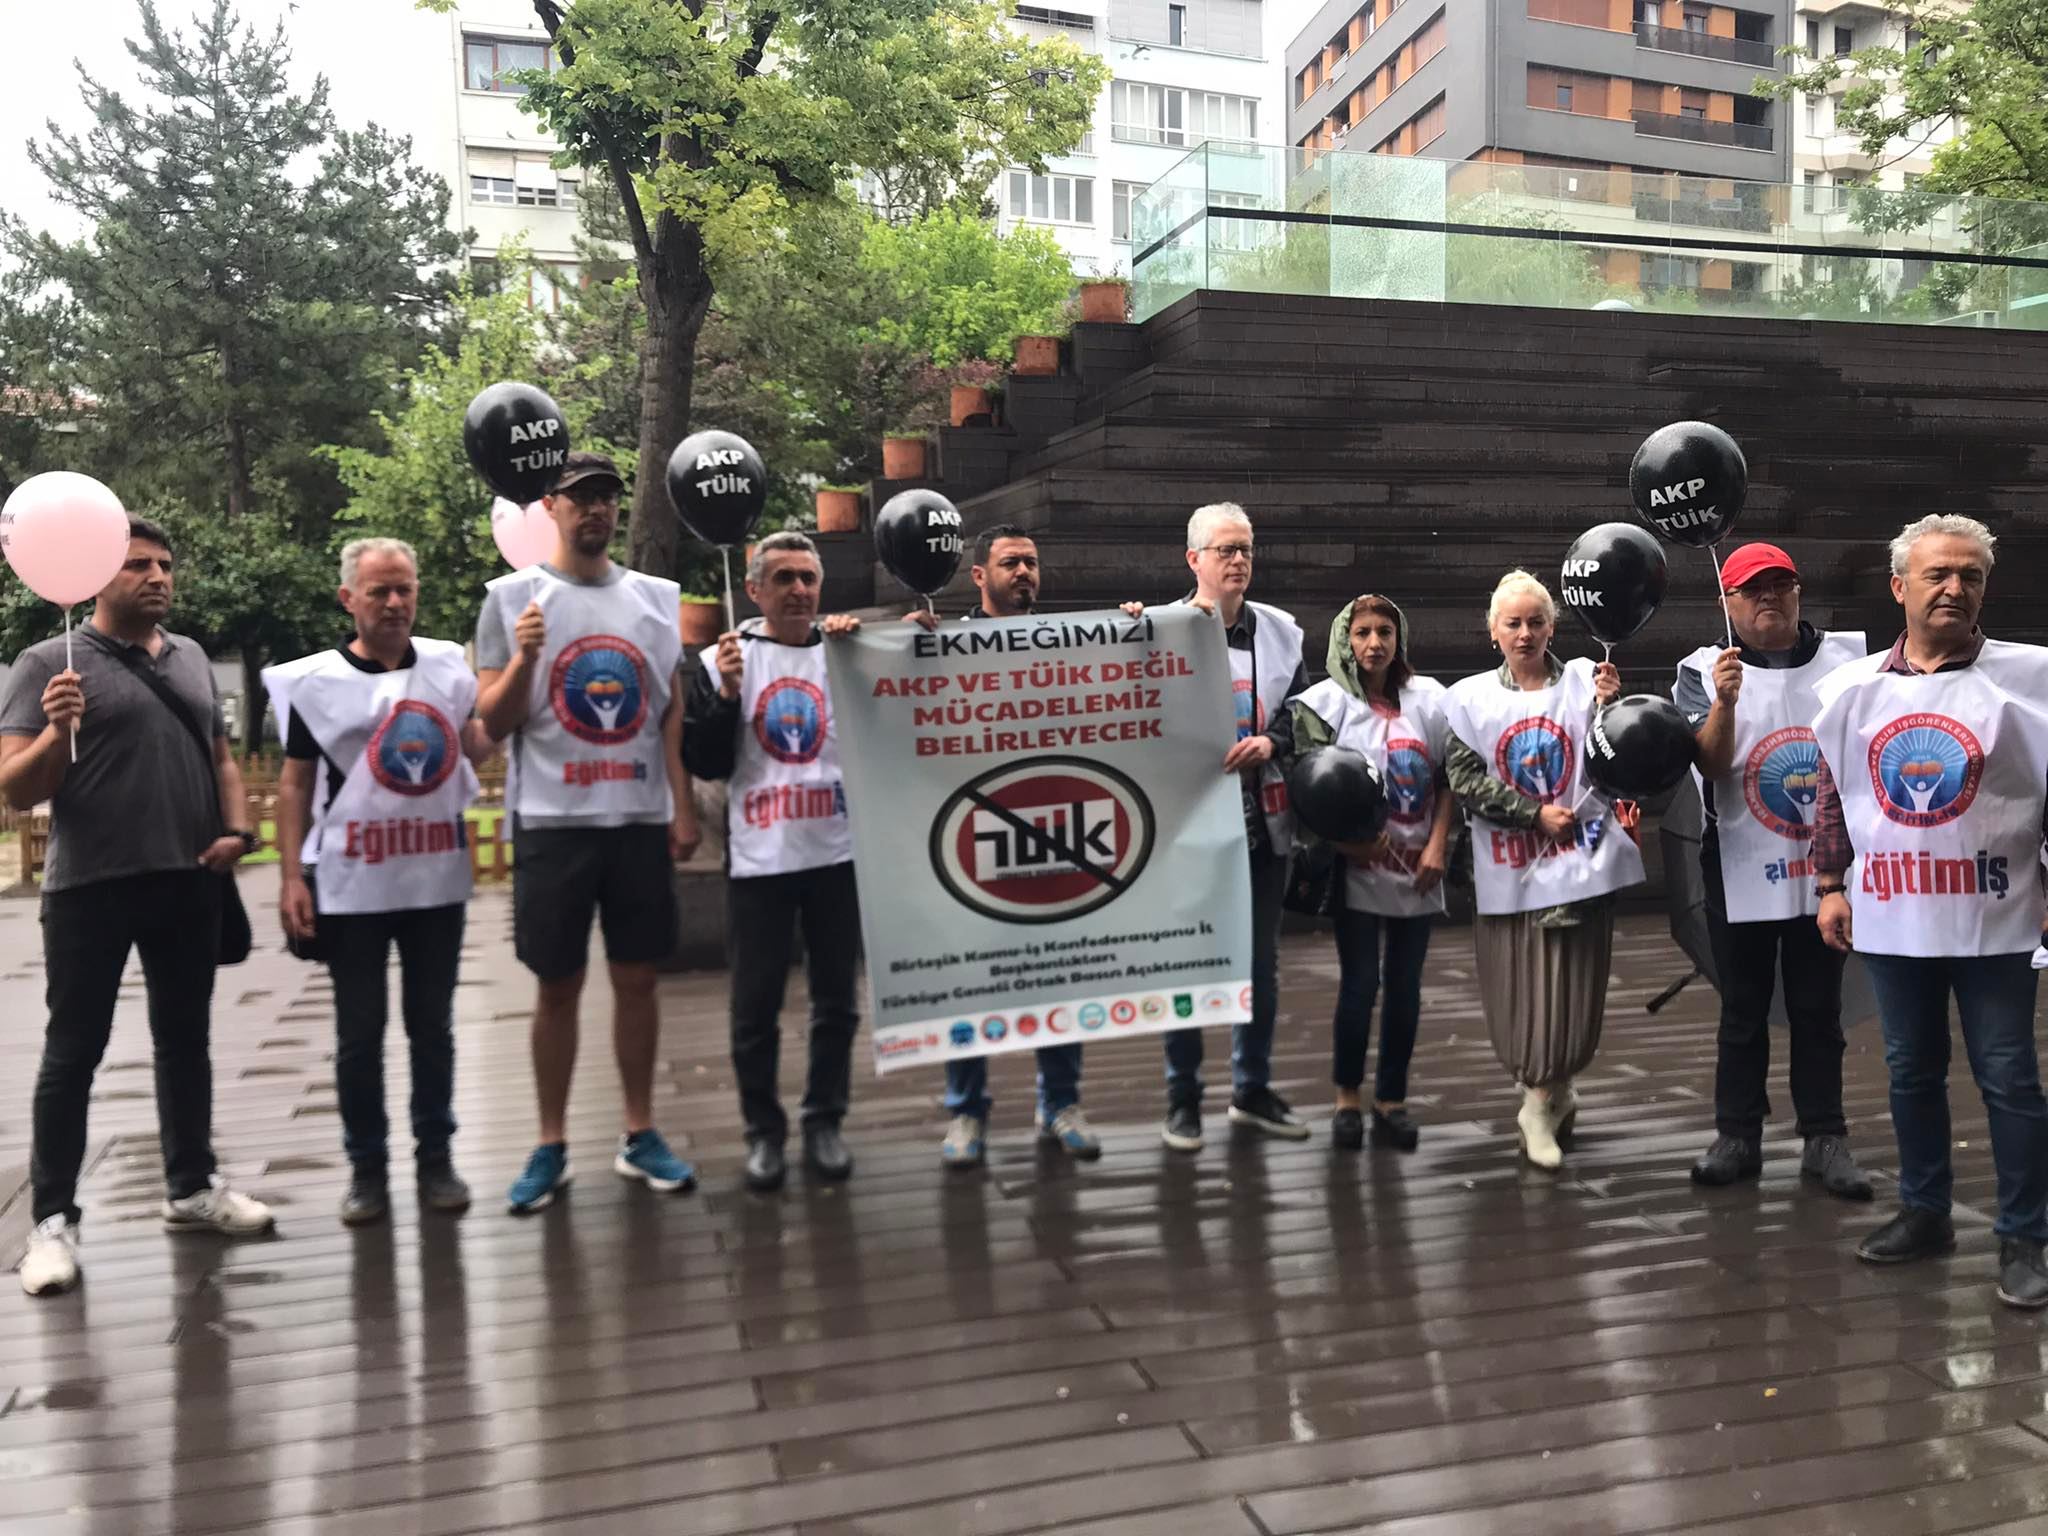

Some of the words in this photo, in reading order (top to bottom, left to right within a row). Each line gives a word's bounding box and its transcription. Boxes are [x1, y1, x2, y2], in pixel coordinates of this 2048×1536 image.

[511, 418, 559, 445] AKP
[510, 447, 565, 473] TÜİK
[696, 449, 745, 471] AKP
[695, 472, 752, 498] TÜİK
[1650, 477, 1706, 507] AKP
[927, 509, 962, 527] AKP
[1655, 504, 1720, 531] TÜİK
[1561, 559, 1601, 578] AKP
[914, 614, 1155, 659] EKMEĞİMİZİ
[872, 675, 949, 698] AKP
[956, 671, 1001, 695] VE
[1008, 660, 1094, 690] TÜİK
[1100, 650, 1194, 684] DEĞİL
[912, 683, 1163, 727] MÜCADELEMİZ
[914, 718, 1164, 758] BELİRLEYECEK
[344, 815, 468, 865] Eğitimi
[1862, 850, 2010, 900] Eğitimiş
[889, 953, 961, 974] Birleşik
[1044, 927, 1196, 953] Konfederasyonu
[989, 952, 1117, 977] Başkanlıkları
[881, 990, 949, 1009] Türkiye
[952, 979, 1011, 999] Geneli
[1013, 971, 1067, 991] Ortak
[1070, 967, 1122, 984] Basın
[1125, 956, 1232, 978] Açıklaması
